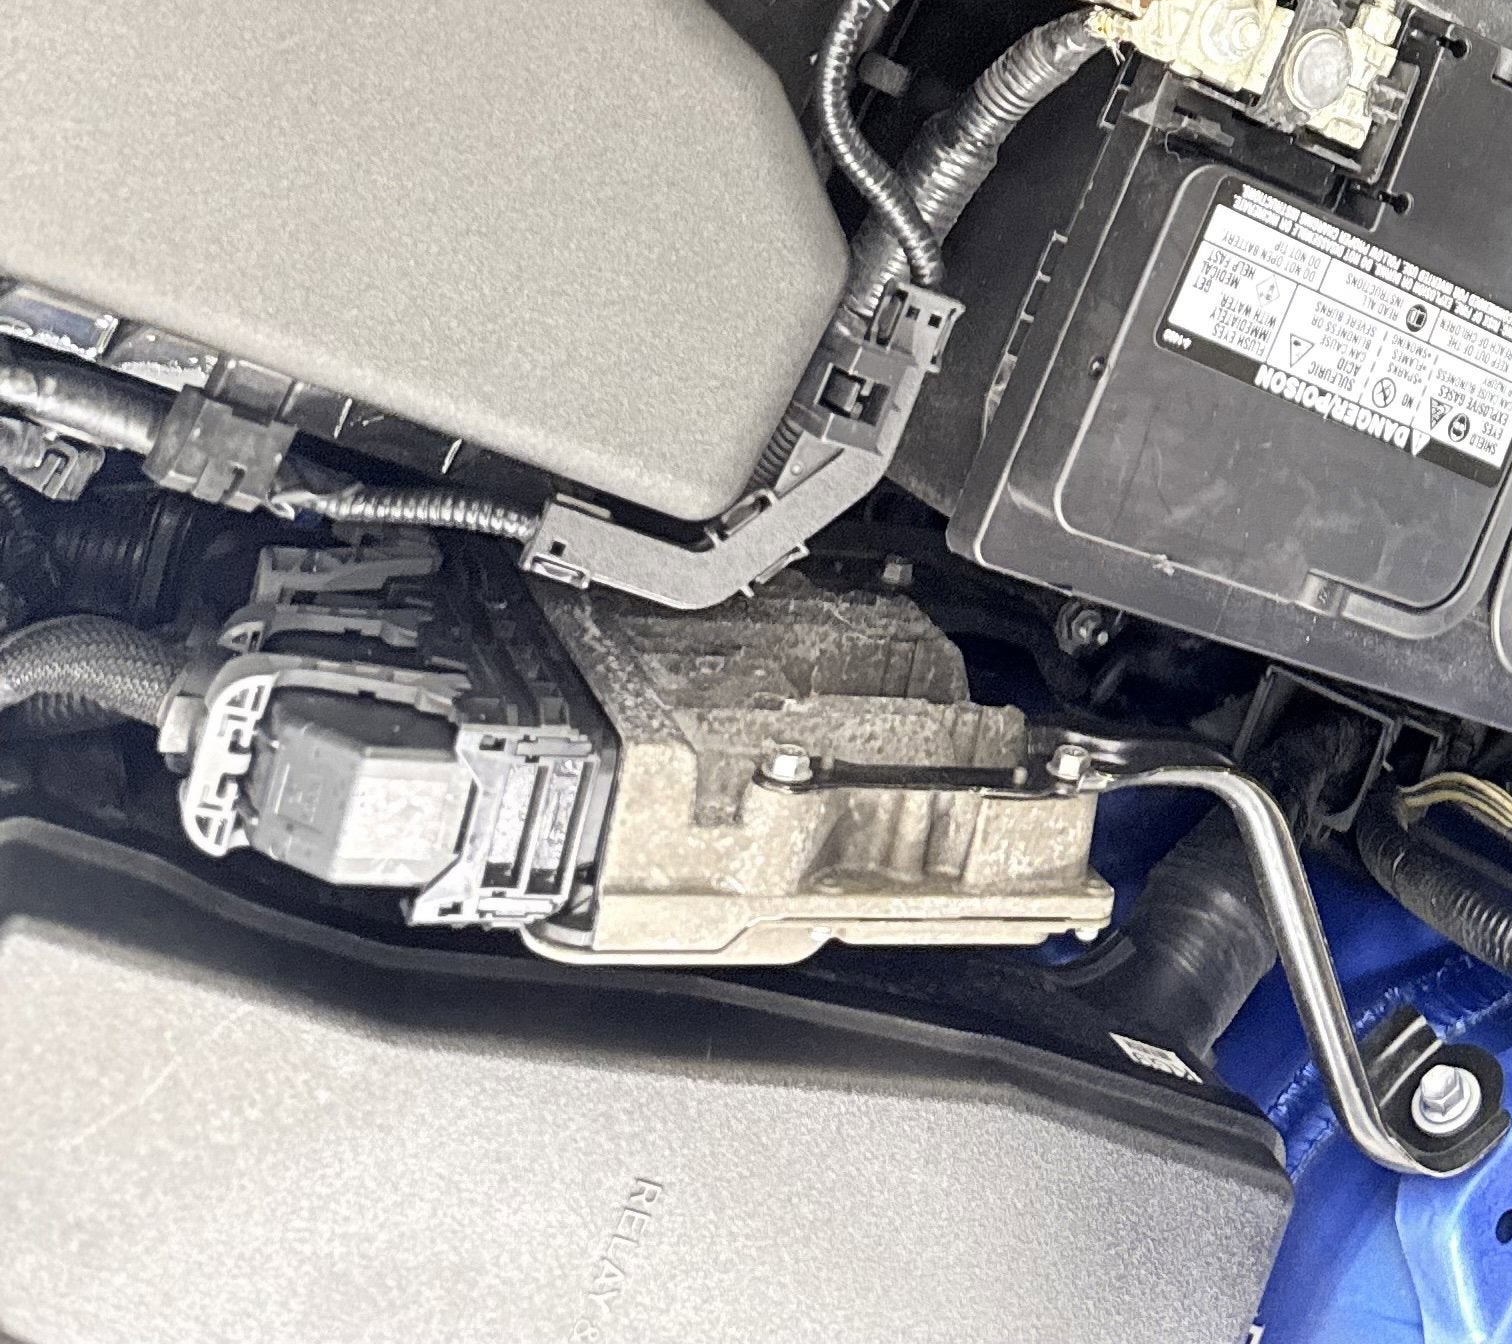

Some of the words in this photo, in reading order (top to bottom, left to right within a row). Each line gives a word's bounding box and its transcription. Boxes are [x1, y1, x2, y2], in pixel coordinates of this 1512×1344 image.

[1259, 248, 1283, 267] OPEN
[1289, 246, 1308, 262] NOT
[1307, 254, 1322, 269] DO
[1198, 259, 1242, 289] MEDICAL
[1231, 258, 1257, 279] HELP
[1283, 259, 1302, 276] NOT
[1302, 268, 1316, 282] DO
[1192, 273, 1213, 293] GET
[1344, 271, 1405, 309] INSTRUCTIONS
[1313, 300, 1345, 322] BURNS
[1360, 295, 1376, 310] ALL
[1377, 303, 1399, 321] READ
[1209, 305, 1271, 342] IMMEDIATELY
[1252, 308, 1278, 329] WITH
[1309, 314, 1325, 328] OR
[1344, 314, 1377, 337] SEVERE
[1210, 322, 1237, 343] EYES
[1324, 320, 1372, 350] BLINDNESS
[1437, 316, 1479, 344] CHILDREN
[1235, 333, 1266, 357] FLUSH
[1318, 333, 1348, 355] CAUSE
[1445, 335, 1463, 351] THE
[1461, 341, 1475, 356] OF
[1476, 334, 1490, 348] OF
[1347, 346, 1367, 362] CAN
[1473, 347, 1491, 363] OUT
[1489, 354, 1511, 372] KEEP
[1305, 359, 1355, 393] SULFURIC
[1335, 356, 1361, 377] ACID
[1434, 367, 1477, 394] BLINDNESS
[1400, 393, 1415, 408] NO
[1436, 383, 1466, 406] GASES
[1475, 386, 1499, 404] CAUSE
[1252, 363, 1411, 448] DANGER/POISON
[1465, 396, 1510, 426] EXPLOSIVE
[1480, 420, 1504, 440] EYES
[1467, 432, 1498, 456] SHIELD
[583, 1174, 664, 1316] RELAY
